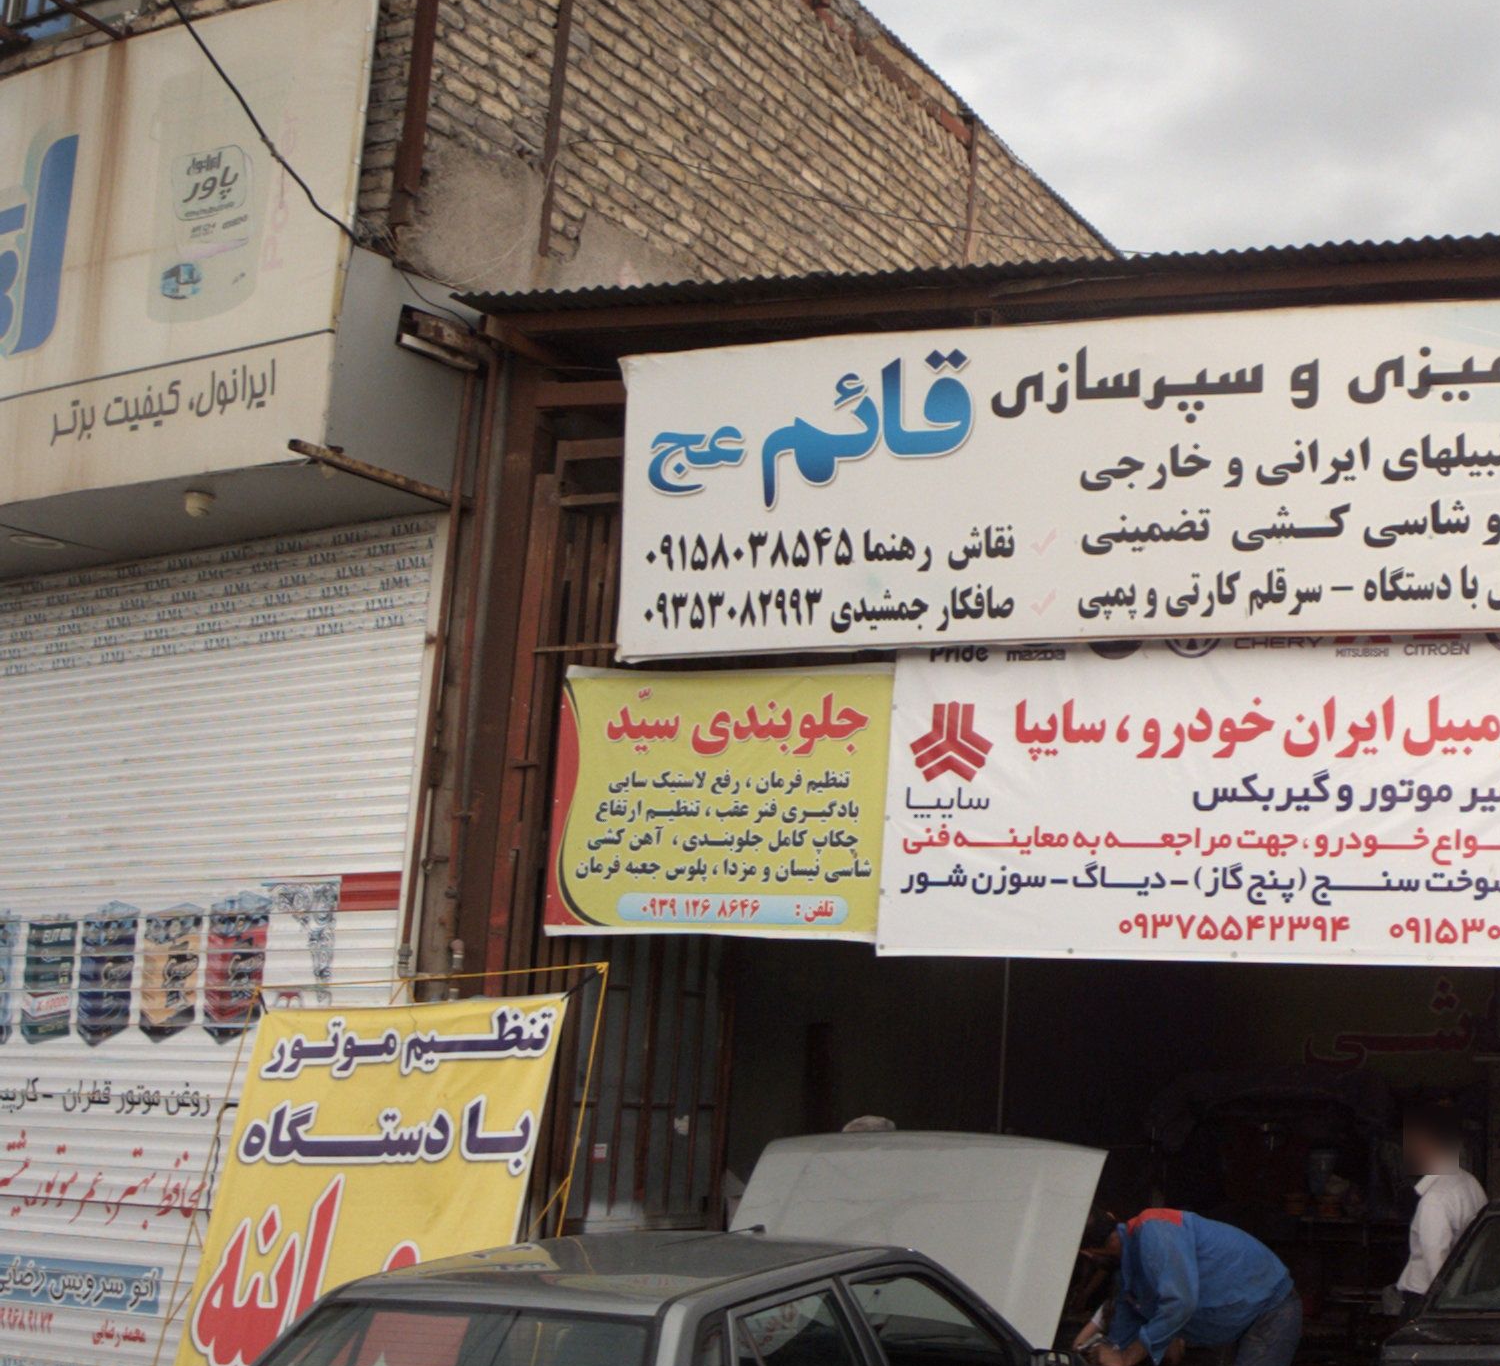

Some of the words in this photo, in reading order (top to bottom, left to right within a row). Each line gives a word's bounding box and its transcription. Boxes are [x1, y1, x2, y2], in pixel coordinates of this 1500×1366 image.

[182, 165, 239, 203] پاور
[1291, 359, 1318, 409] و
[103, 380, 181, 427] کیفیت
[50, 400, 95, 446] برتر
[762, 349, 971, 508] قائم
[648, 426, 743, 493] عج
[1080, 444, 1211, 491] خارجی
[1224, 457, 1243, 487] و
[1256, 437, 1370, 486] ایرانی
[1082, 509, 1210, 555] تضمینی
[1232, 503, 1350, 551] کشی
[1364, 500, 1469, 548] شاسی
[646, 527, 852, 571] ۰۹۱۵۸۰۳۸۵۴۵
[864, 530, 931, 571] رهنما
[948, 525, 1014, 570] نقاش
[1166, 571, 1240, 617] کارتی
[1249, 568, 1322, 615] سرقلم
[1364, 567, 1451, 601] دستگاه
[1461, 565, 1478, 599] با
[645, 589, 822, 629] ۰۹۳۵۳۰۸۲۹۹۳
[831, 590, 928, 633] جمشیدی
[936, 586, 1014, 631] صافکار
[1078, 585, 1136, 620] پمپی
[1144, 588, 1157, 618] و
[930, 643, 989, 664] Pride
[1233, 636, 1324, 650] CHERY
[1335, 647, 1390, 658] MITSUBISHI
[1404, 641, 1471, 656] CITROËN
[692, 693, 868, 754] جلوبندی
[1015, 699, 1106, 761] سایپا
[1136, 697, 1274, 758] خودرو
[1284, 696, 1394, 758] ایران
[608, 771, 647, 794] سایی
[652, 770, 707, 791] لاستیک
[710, 772, 740, 796] رفع
[755, 772, 802, 794] فرمان
[806, 771, 851, 794] تنظیم
[1193, 770, 1329, 811] گیربکس
[595, 799, 642, 823] ارتفاع
[645, 799, 701, 823] تنظیم
[715, 801, 750, 819] عقب
[753, 798, 778, 823] فنر
[906, 787, 989, 818] سایپا
[1336, 785, 1353, 812] و
[1360, 785, 1452, 812] موتور
[587, 827, 625, 851] کشی
[628, 825, 663, 851] آهن
[682, 827, 764, 854] جلوبندی
[768, 829, 808, 852] کامل
[902, 823, 951, 856] فنی
[953, 825, 1070, 859] معاینه
[1072, 831, 1101, 858] به
[1104, 826, 1233, 860] مراجعه
[1237, 829, 1300, 861] جهت
[1315, 827, 1430, 858] خودرو
[575, 856, 621, 881] فرمان
[723, 857, 757, 881] مزدا
[763, 866, 771, 882] و
[775, 858, 820, 882] نیسان
[824, 858, 872, 883] شاسی
[899, 863, 968, 895] شور
[970, 863, 1047, 897] سوزن
[1310, 868, 1421, 906] سنج
[1119, 913, 1350, 942] ۰۹۳۷۵۵۴۲۳۹۴
[266, 1020, 398, 1076] موتور
[405, 1009, 553, 1072] تنظیم
[62, 1079, 112, 1113] قطران
[116, 1085, 160, 1115] موتور
[165, 1082, 211, 1116] روغن
[243, 1104, 452, 1161] دستگاه
[463, 1100, 533, 1173] با
[49, 1274, 125, 1302] سرویس
[127, 1267, 157, 1310] اتو
